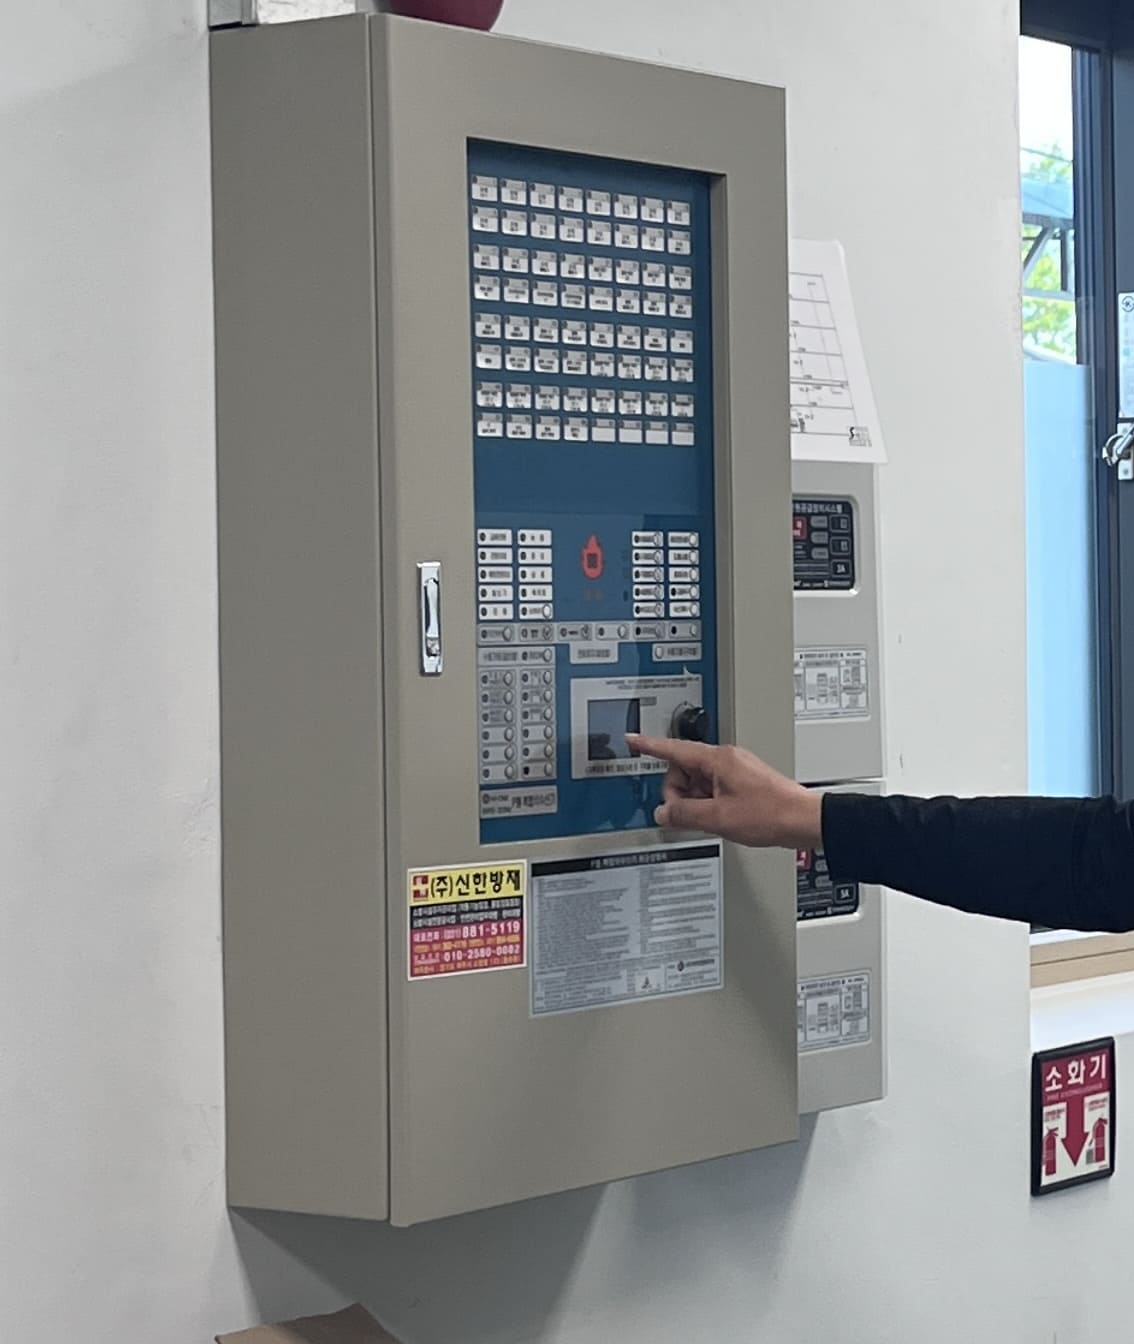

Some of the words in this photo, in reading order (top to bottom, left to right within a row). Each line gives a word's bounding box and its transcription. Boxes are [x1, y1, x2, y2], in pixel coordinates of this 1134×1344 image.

[430, 869, 521, 898] (주)신한방재
[462, 921, 521, 939] 881-5119
[1044, 1054, 1107, 1092] 소화기
